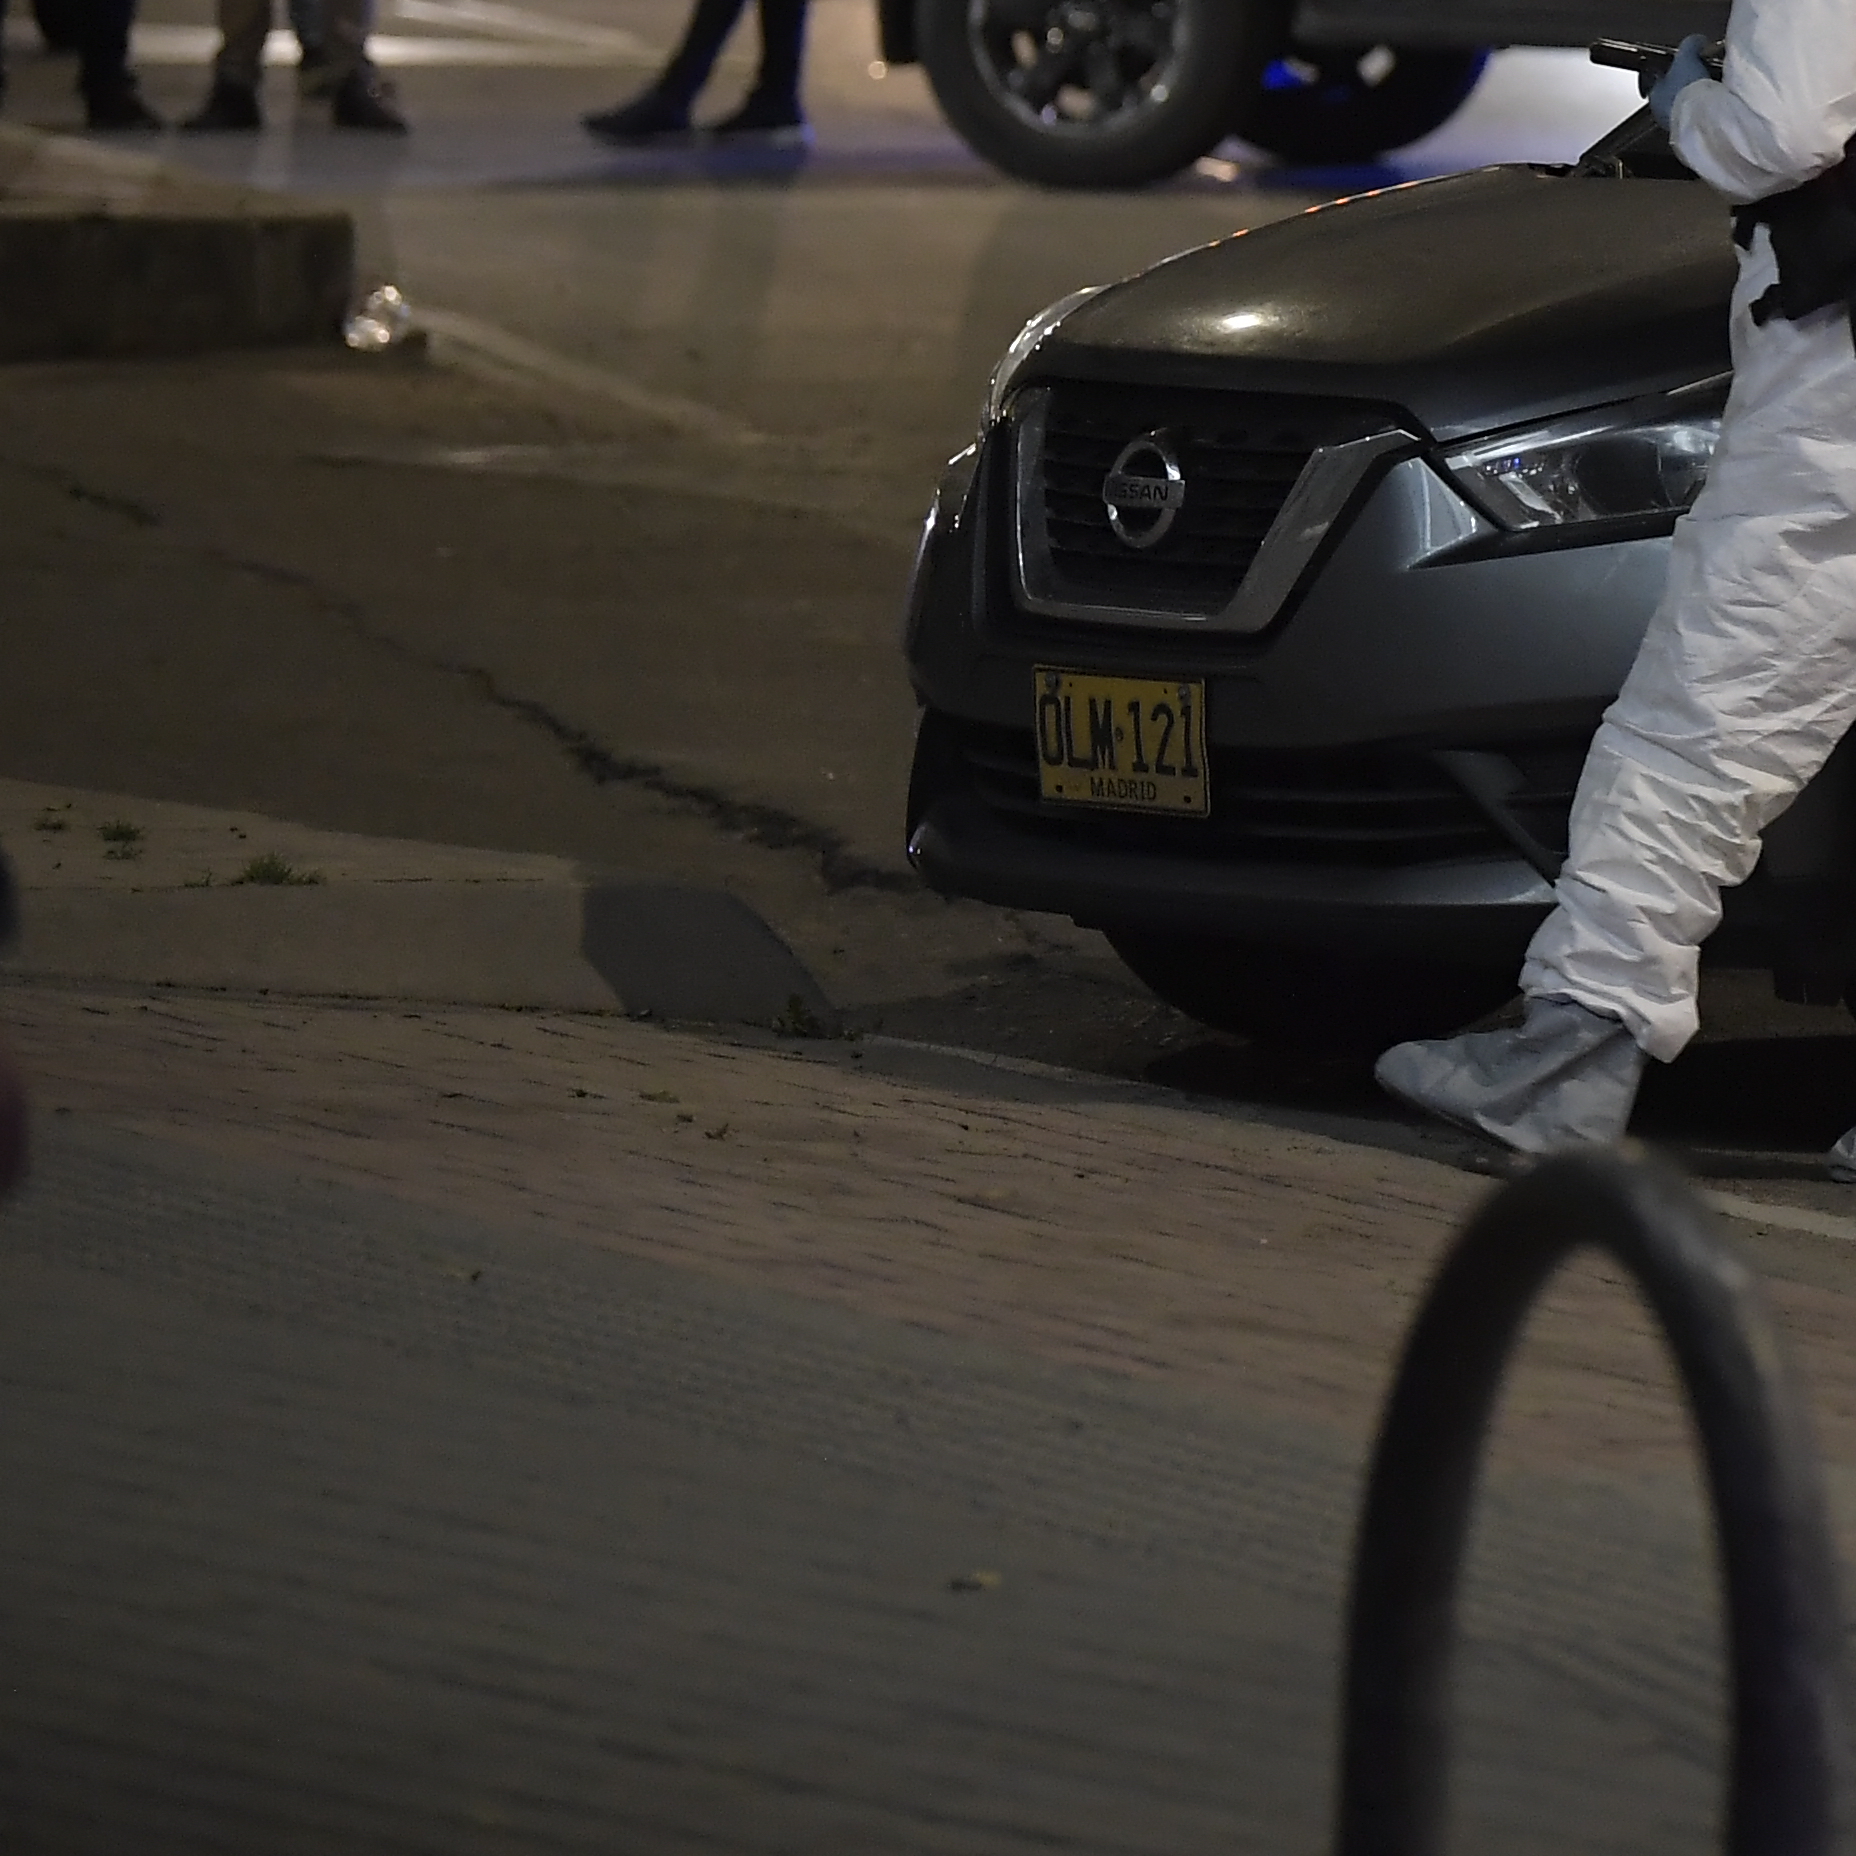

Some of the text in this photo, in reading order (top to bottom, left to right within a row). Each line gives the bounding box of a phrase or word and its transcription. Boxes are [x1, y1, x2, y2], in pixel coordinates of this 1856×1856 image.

[1038, 693, 1199, 778] OLM 121
[1090, 775, 1157, 801] MADRID
